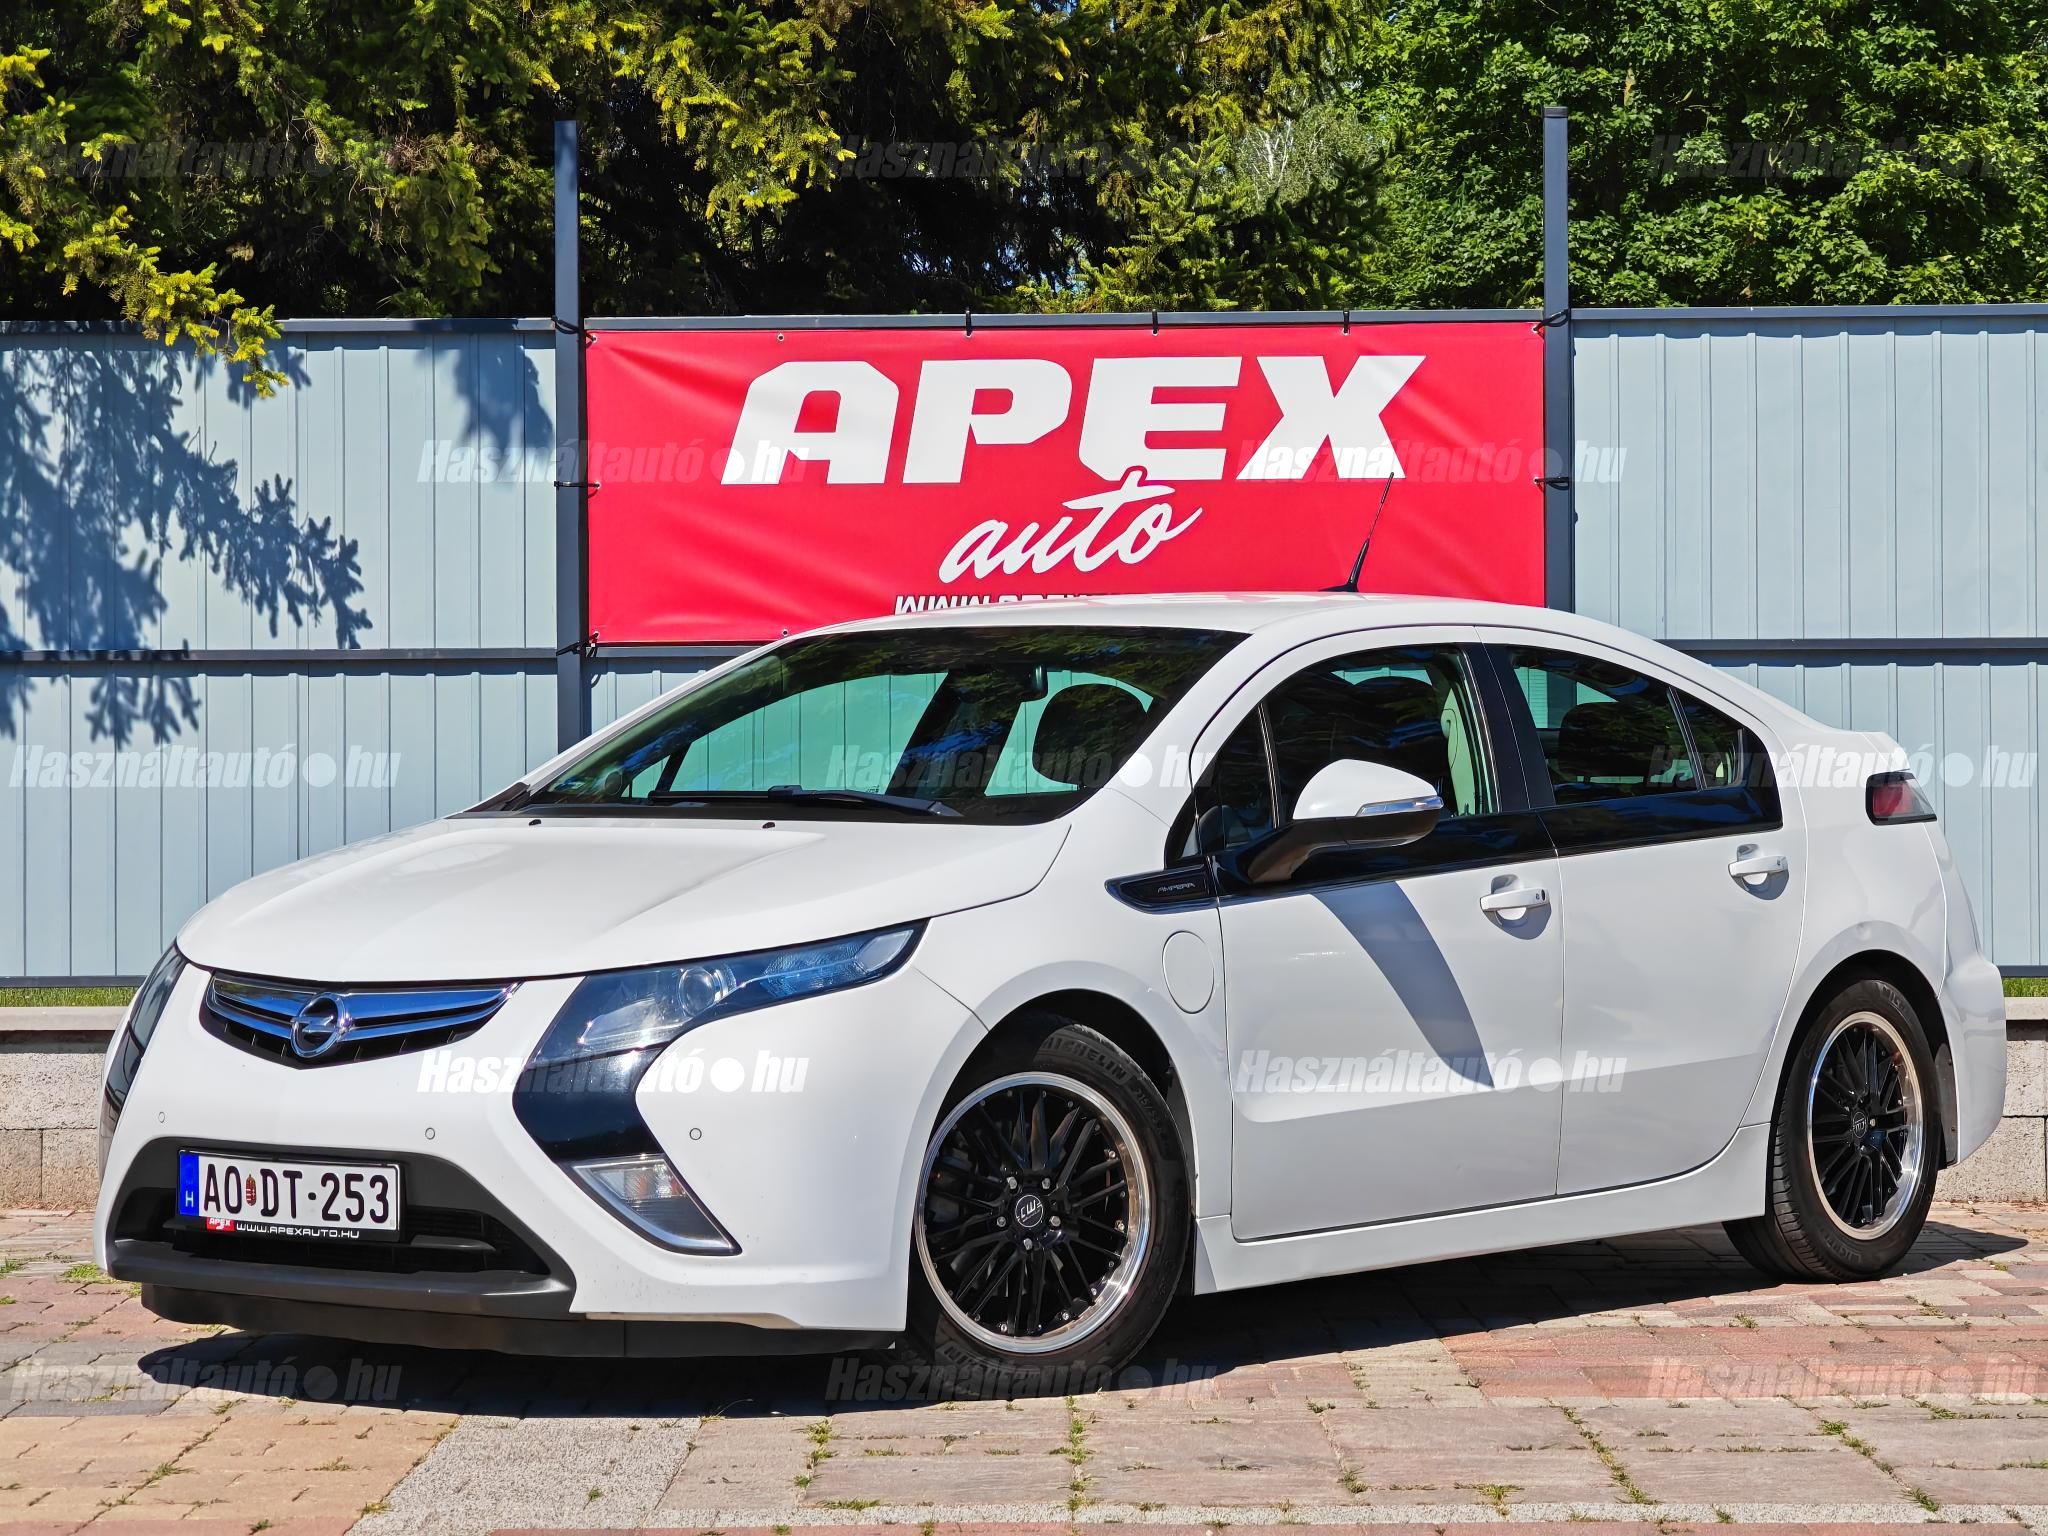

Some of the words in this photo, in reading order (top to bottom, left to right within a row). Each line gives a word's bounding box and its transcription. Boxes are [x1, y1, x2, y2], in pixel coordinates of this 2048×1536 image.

[721, 355, 1425, 484] APEX
[939, 469, 1202, 583] auto
[1157, 882, 1196, 894] AMPERA
[185, 1190, 194, 1208] H
[208, 1217, 231, 1228] APEX
[236, 1222, 360, 1239] WWW.APEXAUTO.HU
